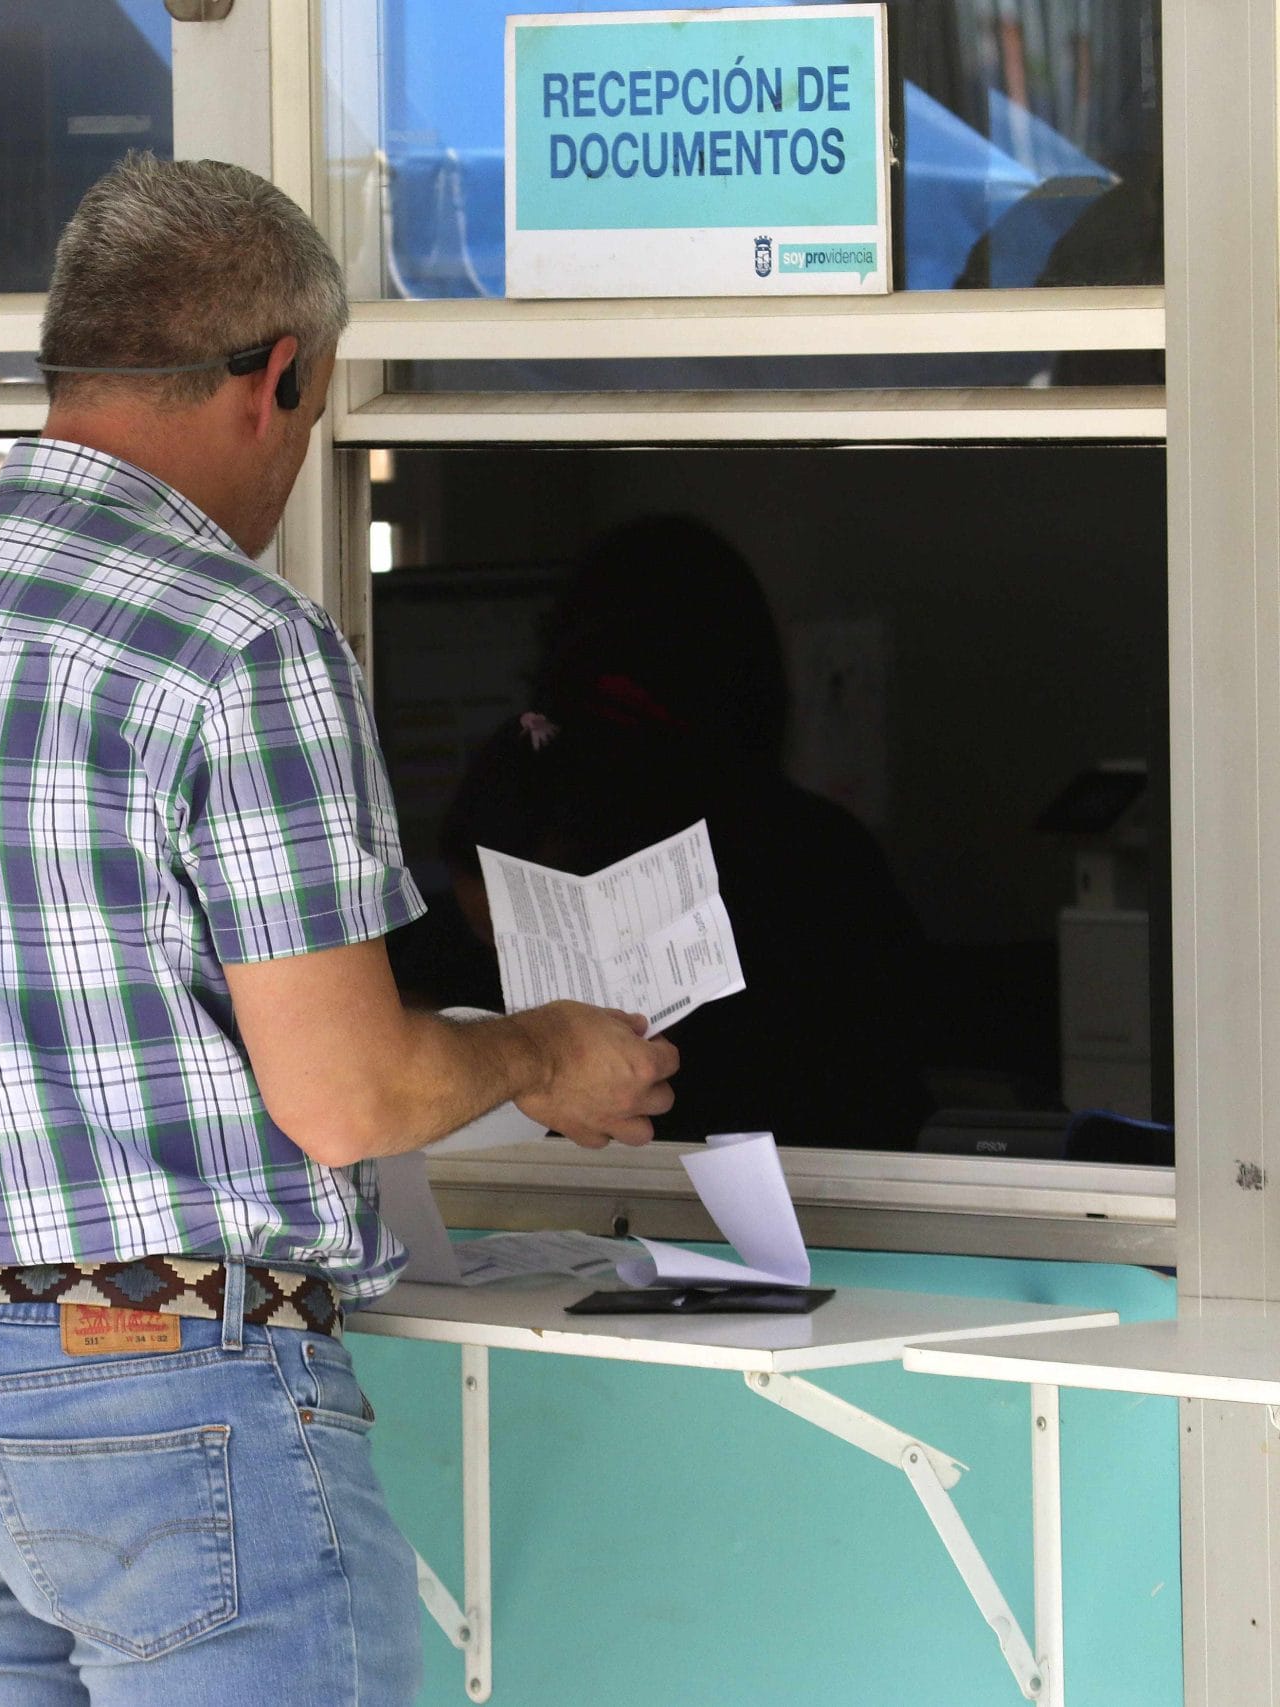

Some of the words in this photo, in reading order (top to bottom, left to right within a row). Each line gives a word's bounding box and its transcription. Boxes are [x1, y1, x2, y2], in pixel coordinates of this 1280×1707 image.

[542, 55, 783, 118] RECEPCIÓN
[797, 65, 851, 112] DE
[550, 127, 846, 179] DOCUMENTOS
[783, 246, 874, 271] soyprovidencia
